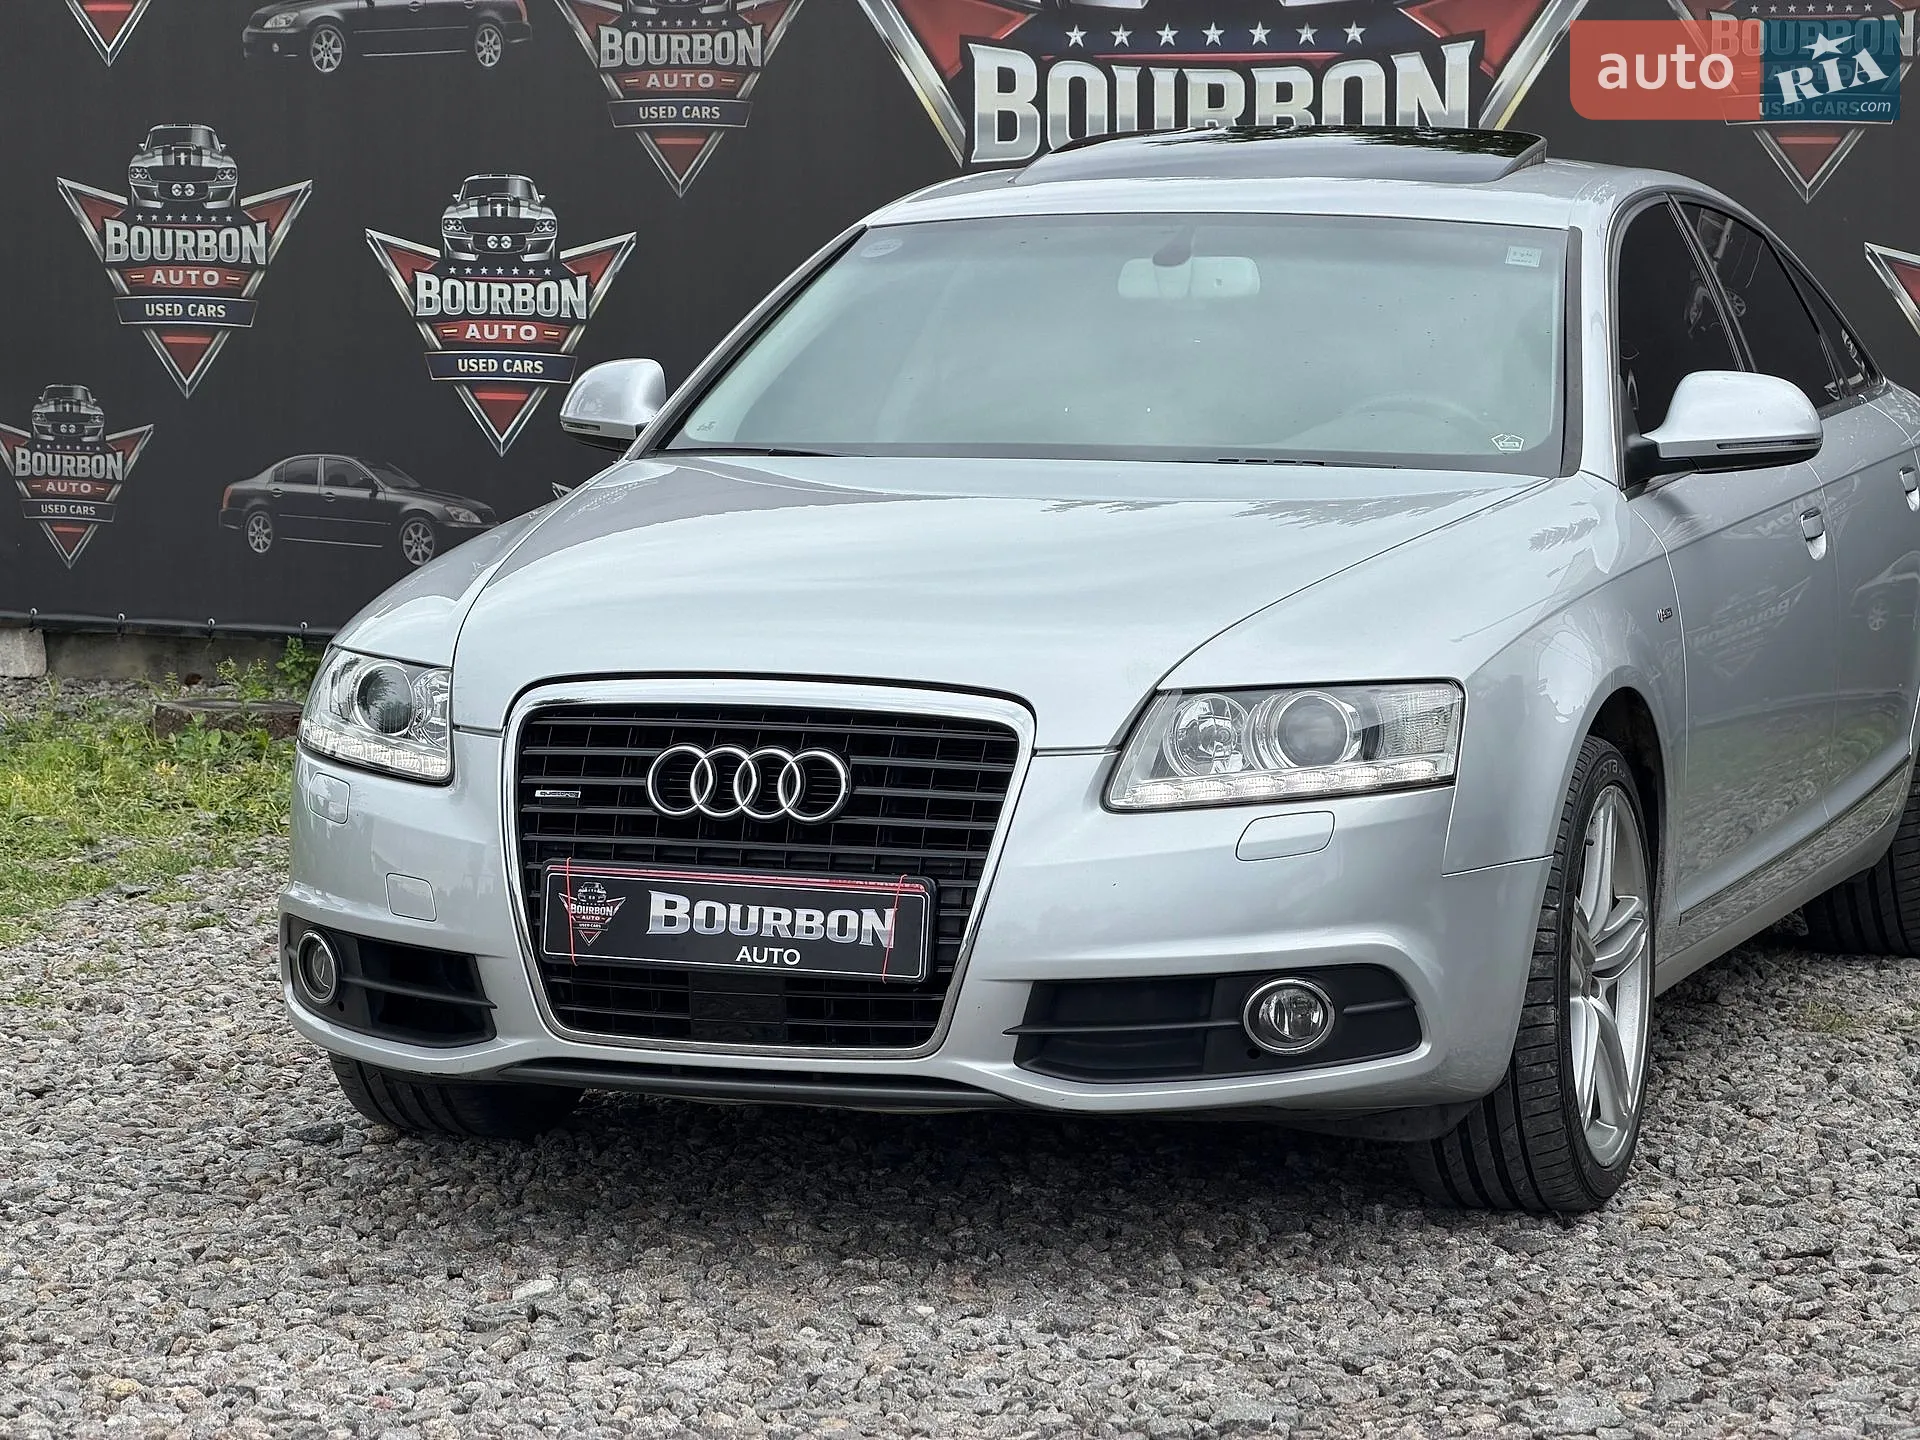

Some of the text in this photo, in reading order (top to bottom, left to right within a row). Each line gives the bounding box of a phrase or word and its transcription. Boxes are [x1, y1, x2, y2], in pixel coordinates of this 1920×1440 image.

[598, 25, 763, 68] BOURBON
[646, 73, 715, 88] AUTO
[968, 40, 1475, 163] BOURBON
[639, 106, 720, 119] USED CARS
[104, 218, 267, 265] BOURBON
[151, 269, 220, 286] AUTO
[415, 271, 588, 320] BOURBON
[145, 303, 226, 318] USED CARS
[465, 323, 537, 341] AUTO
[457, 359, 544, 374] USED CARS
[14, 446, 124, 481] BOURBON
[46, 481, 92, 493] AUTO
[41, 504, 96, 516] USED CARS
[570, 903, 614, 916] BOURBON
[645, 890, 897, 949] BOURBON
[735, 945, 801, 965] AUTO
